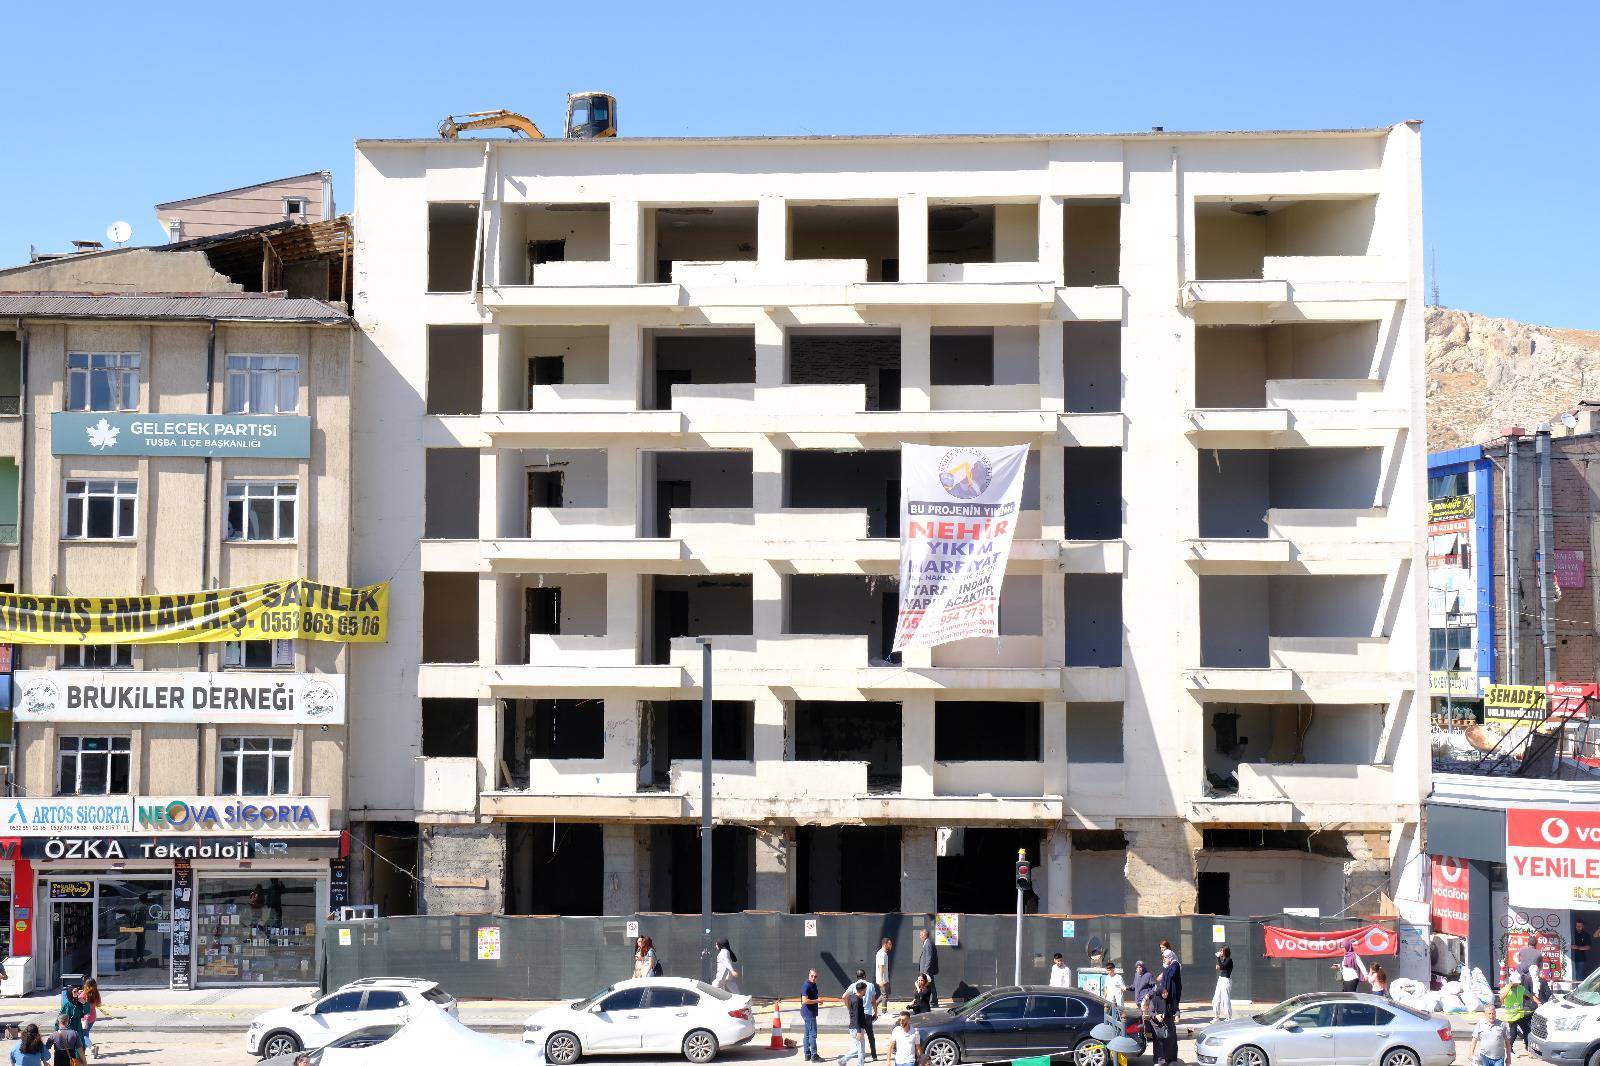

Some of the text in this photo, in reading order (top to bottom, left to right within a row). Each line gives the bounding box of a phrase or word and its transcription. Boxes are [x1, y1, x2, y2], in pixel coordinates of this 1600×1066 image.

[130, 421, 209, 435] GELECEK
[145, 437, 261, 448] TUŞBA İLÇE BAŞKANLIĞI
[910, 504, 925, 514] BU
[928, 505, 980, 516] PROJENİN
[909, 518, 1009, 540] NEHİR
[927, 542, 994, 555] YIKIM
[261, 580, 381, 612] SATILIK
[100, 594, 196, 633] EMLAK
[203, 591, 255, 638] A.Ş.
[261, 611, 300, 633] 0553
[303, 611, 334, 634] 863
[361, 616, 380, 636] 06
[32, 805, 74, 824] ARTOS
[138, 800, 220, 827] NEOVA
[44, 837, 125, 859] ÖZKA
[140, 841, 249, 860] Teknoloji
[1537, 936, 1548, 945] 60
